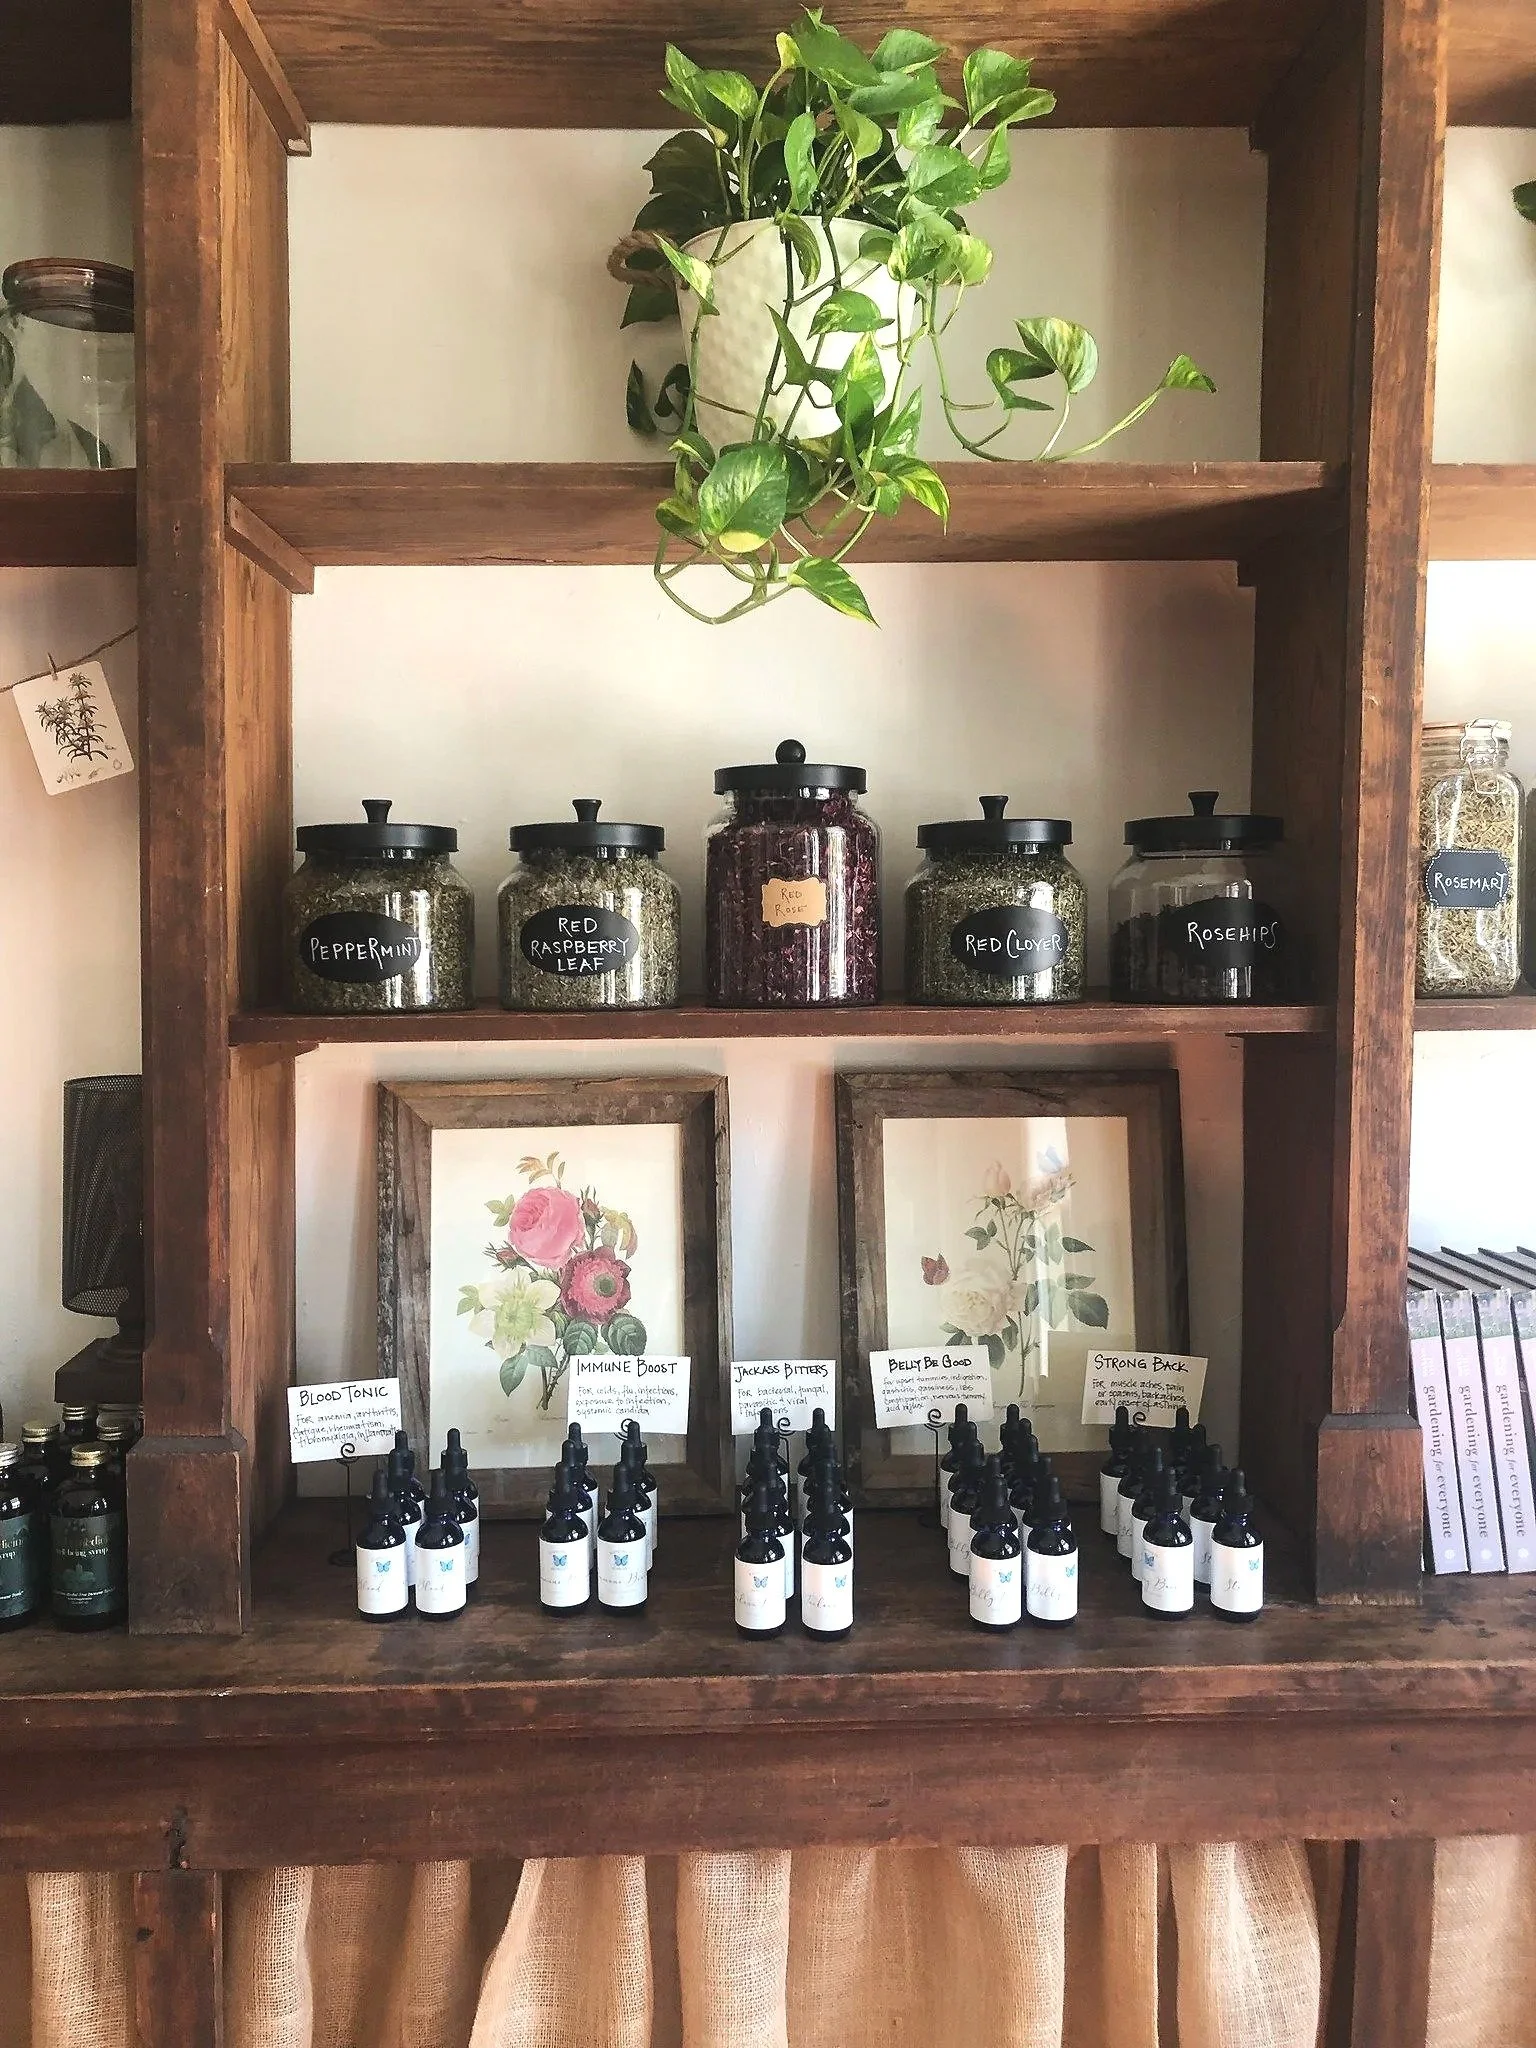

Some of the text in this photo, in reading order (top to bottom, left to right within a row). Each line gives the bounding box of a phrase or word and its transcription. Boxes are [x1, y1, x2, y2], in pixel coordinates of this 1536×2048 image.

[1434, 871, 1508, 897] ROSEMARY
[558, 917, 598, 937] RED
[1187, 921, 1278, 950] ROSEHIPS
[310, 937, 419, 970] PEPPERMINT
[531, 937, 630, 959] RASPBERRY
[965, 929, 1063, 958] RED CLOVER
[557, 957, 605, 972] LEAF
[577, 1357, 678, 1377] IMMUNE BOOST
[734, 1363, 829, 1383] JACKASS BITTERS
[888, 1354, 972, 1373] BELLY BE GOOD
[1094, 1353, 1188, 1373] STRONG BACK
[300, 1385, 388, 1407] BLOOD TONIC
[1423, 1385, 1444, 1456] gardening
[1459, 1385, 1480, 1456] gardening
[1495, 1384, 1517, 1455] gardening
[1433, 1460, 1444, 1472] for
[1468, 1460, 1479, 1472] for
[1505, 1459, 1517, 1471] for
[1436, 1475, 1452, 1538] everyone
[1473, 1475, 1488, 1538] everyone
[1509, 1474, 1526, 1537] everyone
